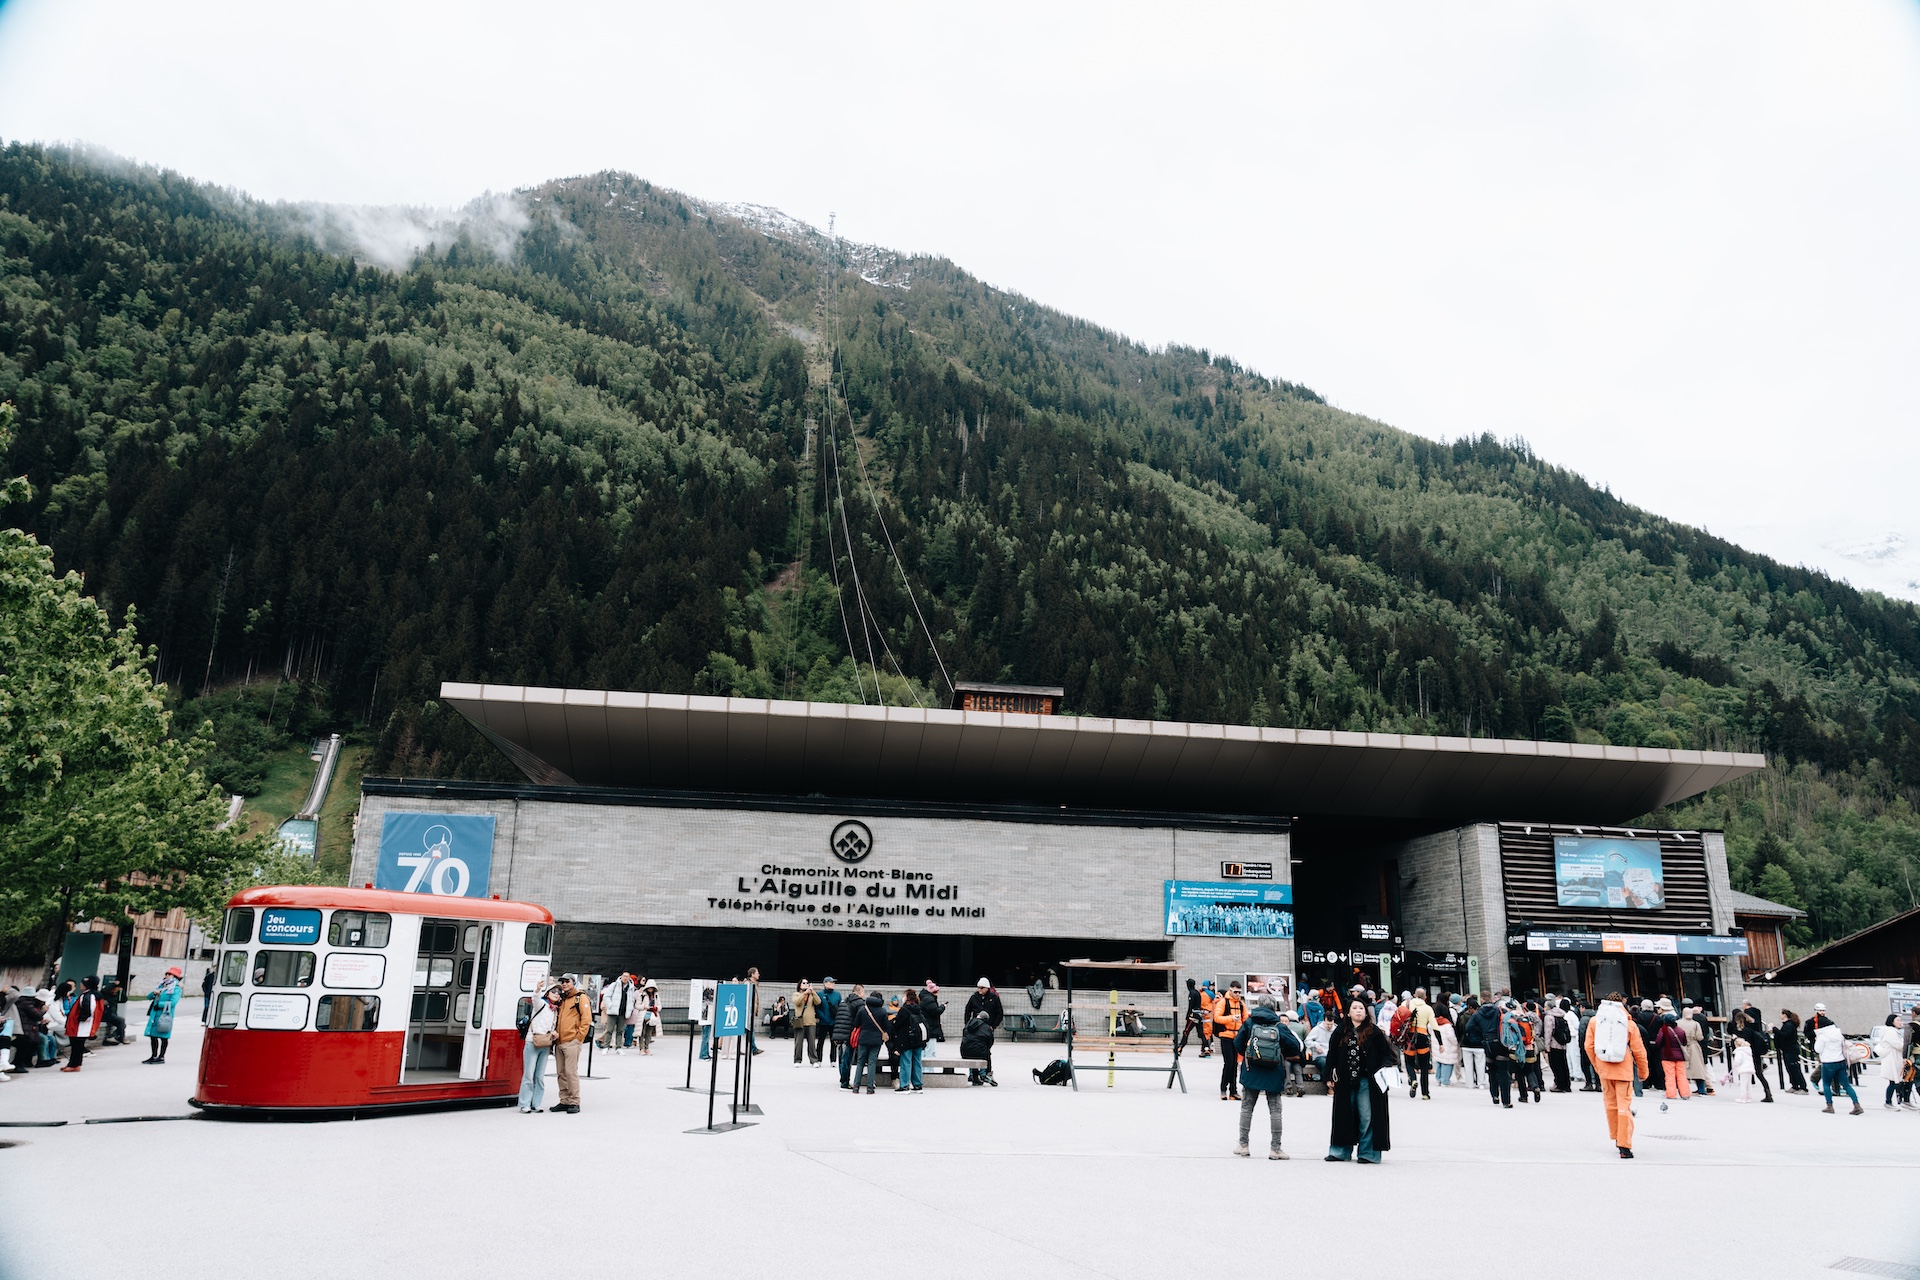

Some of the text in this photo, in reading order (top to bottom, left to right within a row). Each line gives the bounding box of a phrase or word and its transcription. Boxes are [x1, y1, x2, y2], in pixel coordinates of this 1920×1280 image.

[398, 857, 470, 897] 70
[762, 864, 934, 880] Chamonix Mont-Blanc
[1230, 864, 1241, 876] 17
[738, 877, 958, 900] L'Aiguille du Midi
[708, 898, 986, 918] Téléphérique de l'Aiguille du Midi
[267, 914, 285, 924] Jeu
[806, 918, 834, 927] 1030
[847, 920, 876, 928] 3842
[266, 925, 314, 933] concours
[725, 1005, 738, 1026] 70
